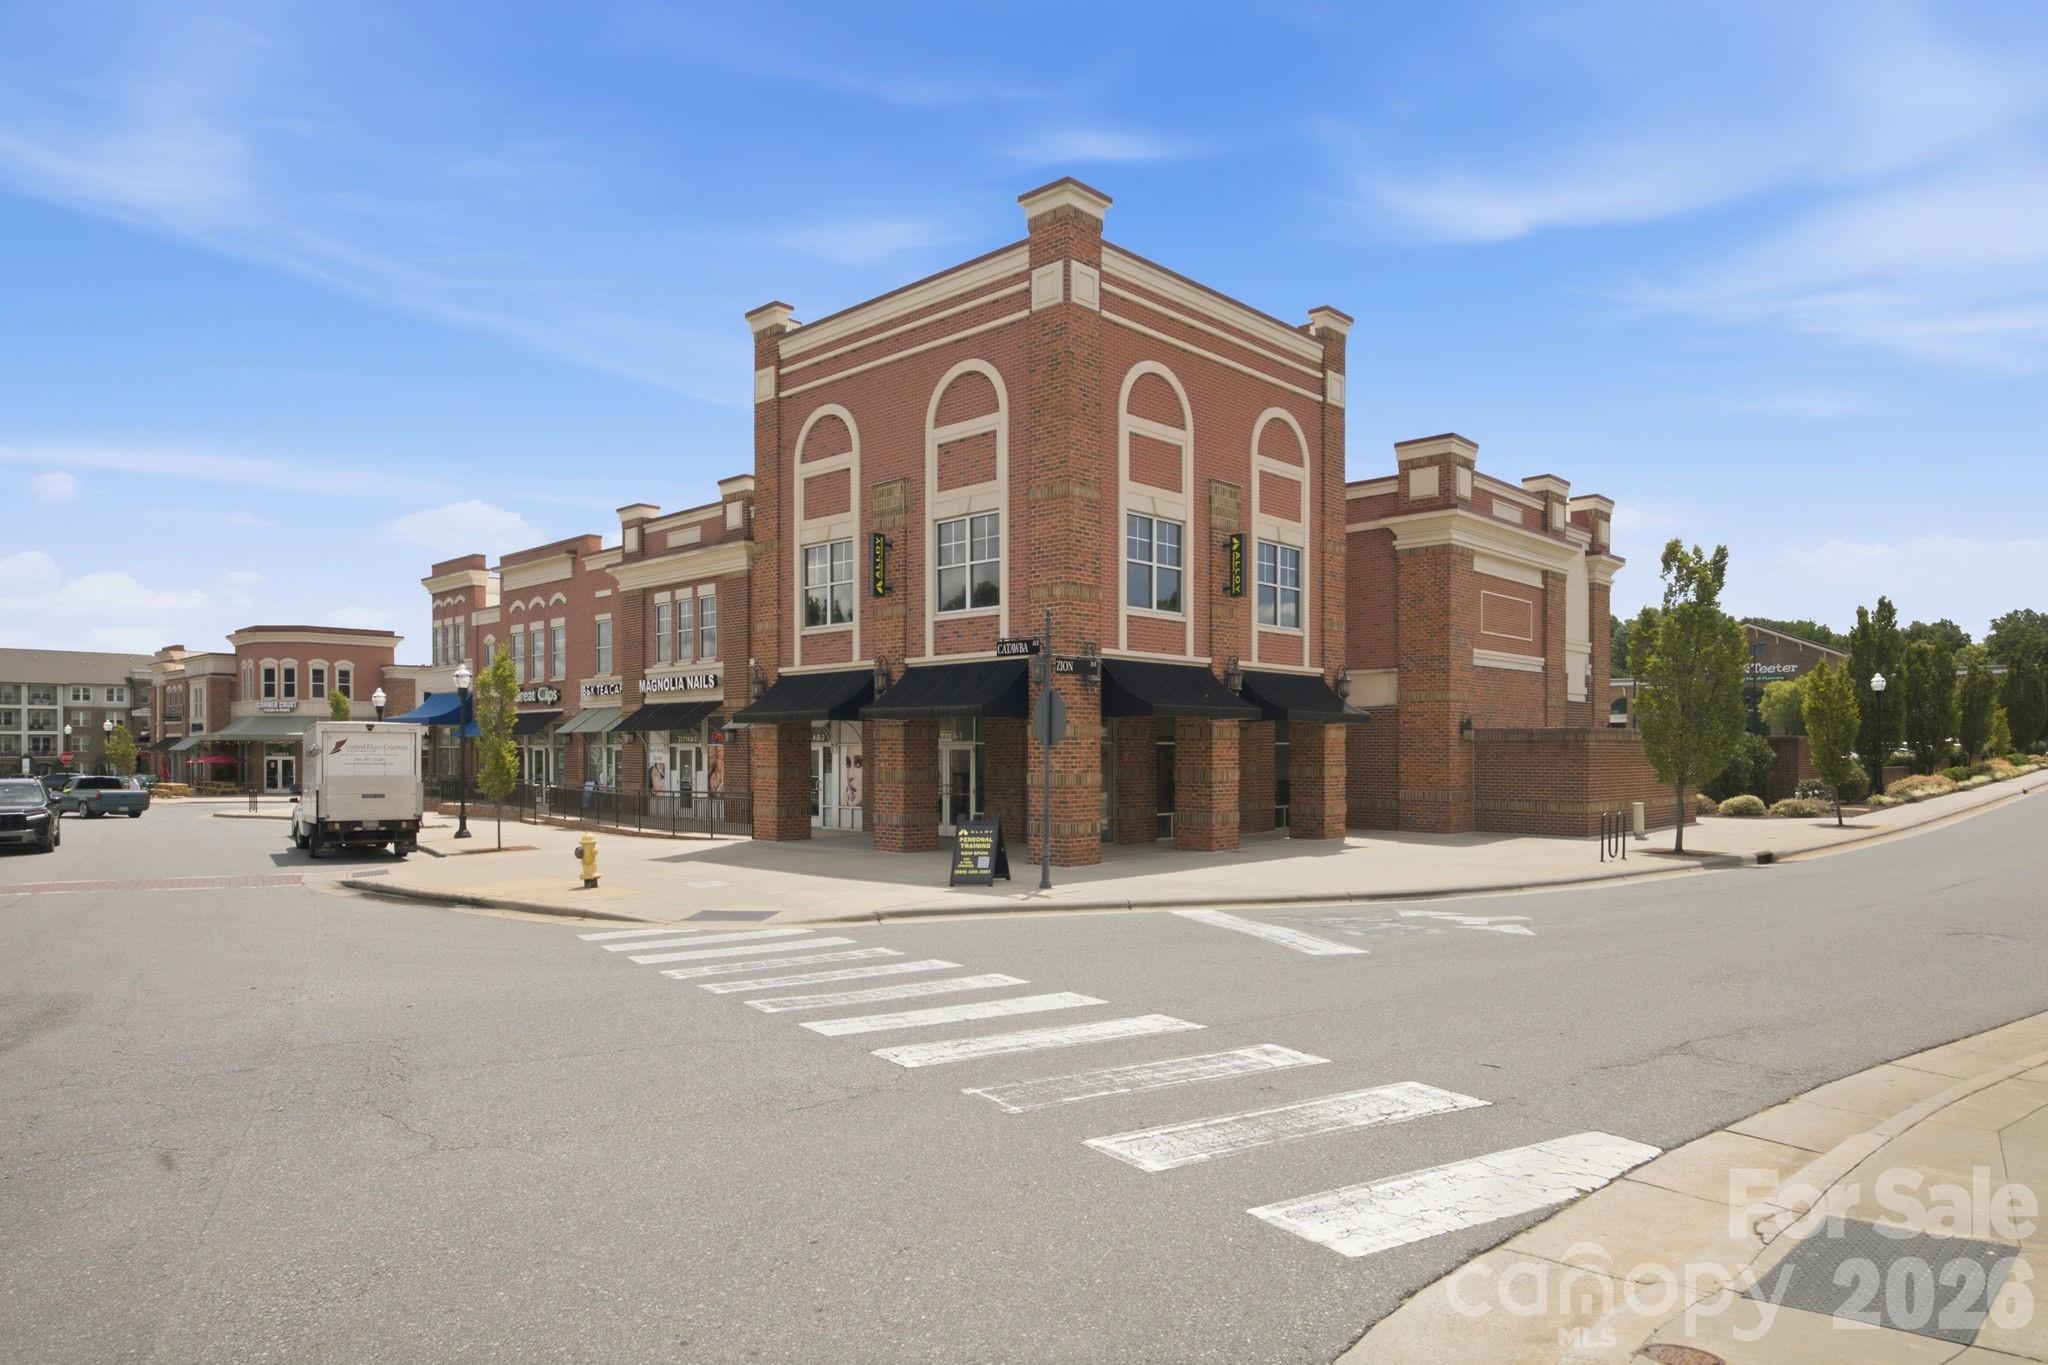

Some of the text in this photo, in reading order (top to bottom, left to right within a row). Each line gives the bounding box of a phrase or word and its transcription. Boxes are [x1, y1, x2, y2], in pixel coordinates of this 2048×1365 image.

[997, 642, 1029, 655] CATAWBA
[1056, 660, 1073, 672] ZION
[1751, 662, 1798, 674] Teeter
[639, 674, 715, 693] MAGNOLIA NAILS
[537, 687, 558, 705] Clips
[582, 685, 595, 696] BSK
[597, 684, 609, 695] TEA
